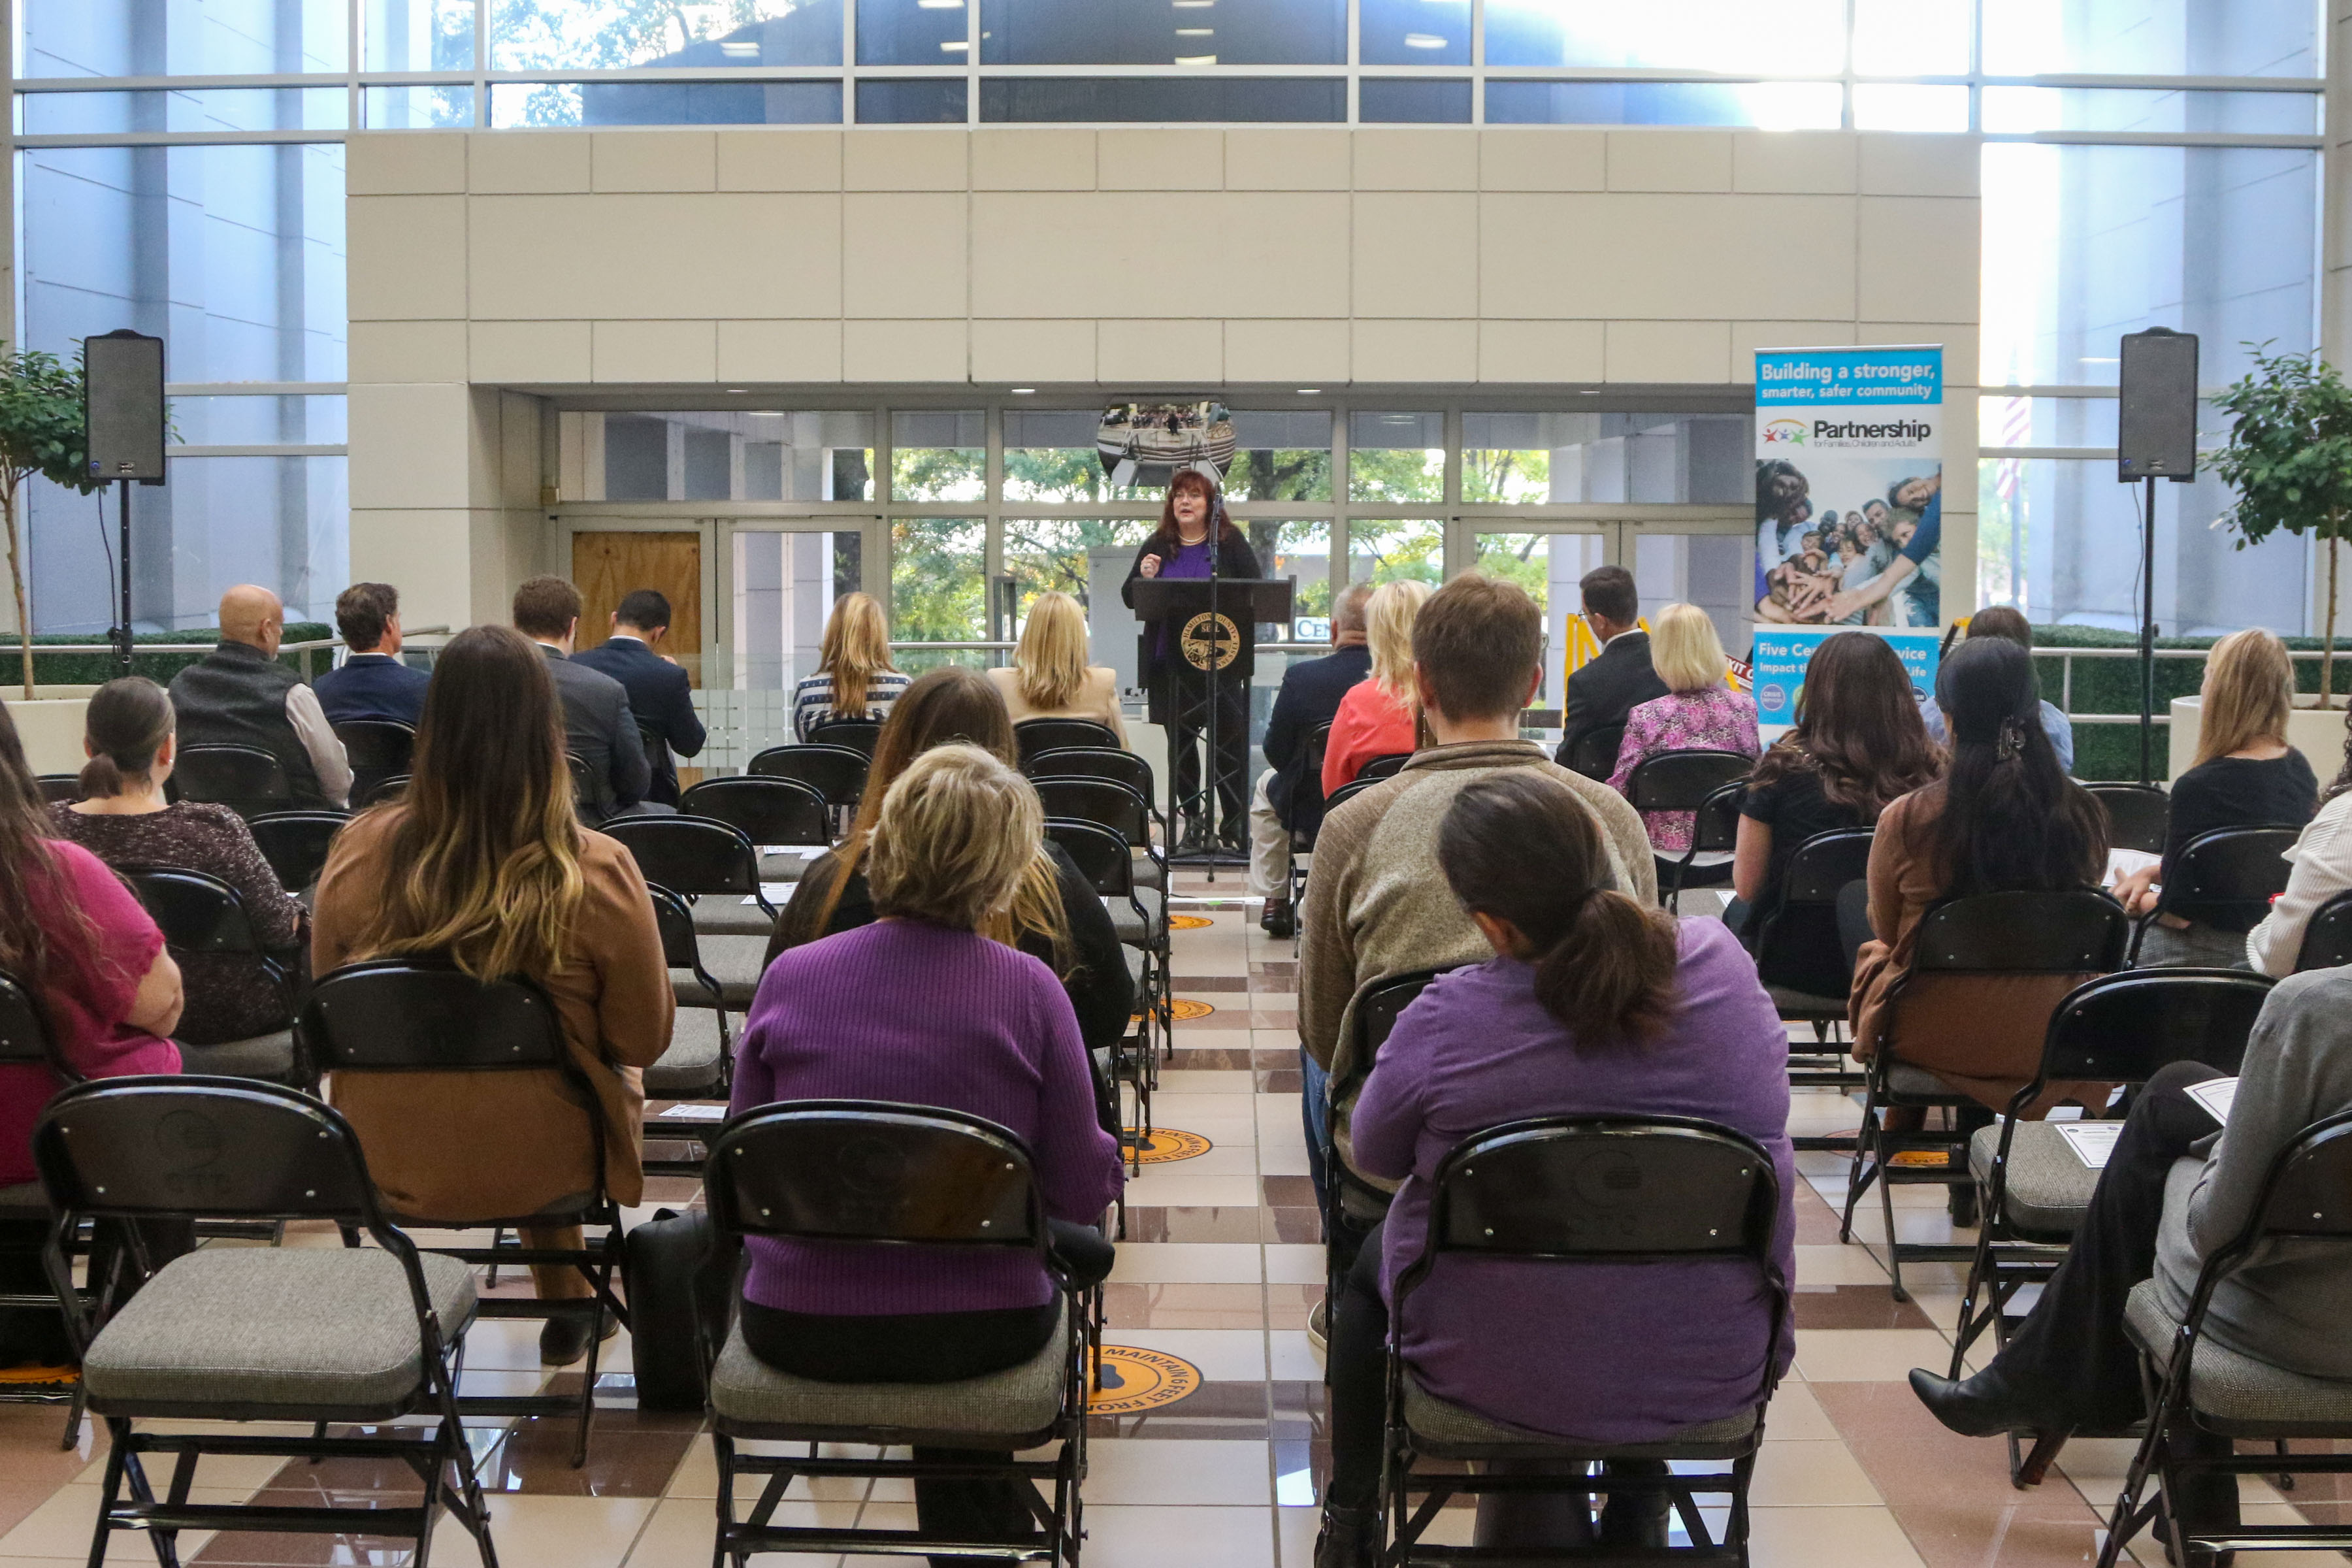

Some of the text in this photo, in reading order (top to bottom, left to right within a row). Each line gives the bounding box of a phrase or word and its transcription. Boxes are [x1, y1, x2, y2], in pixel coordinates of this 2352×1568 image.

[1761, 362, 1935, 384] Building a stronger,
[1761, 383, 1932, 400] smarter, safer community
[1814, 419, 1931, 442] Partnership
[1201, 623, 1220, 632] SEL
[1216, 614, 1236, 634] OUNTY
[1759, 642, 1788, 656] Five
[1895, 646, 1927, 660] vice
[1727, 657, 1747, 674] XIT
[1759, 662, 1796, 674] Impact
[1105, 1348, 1190, 1377] MAINTAIN
[1147, 1384, 1186, 1403] FEET
